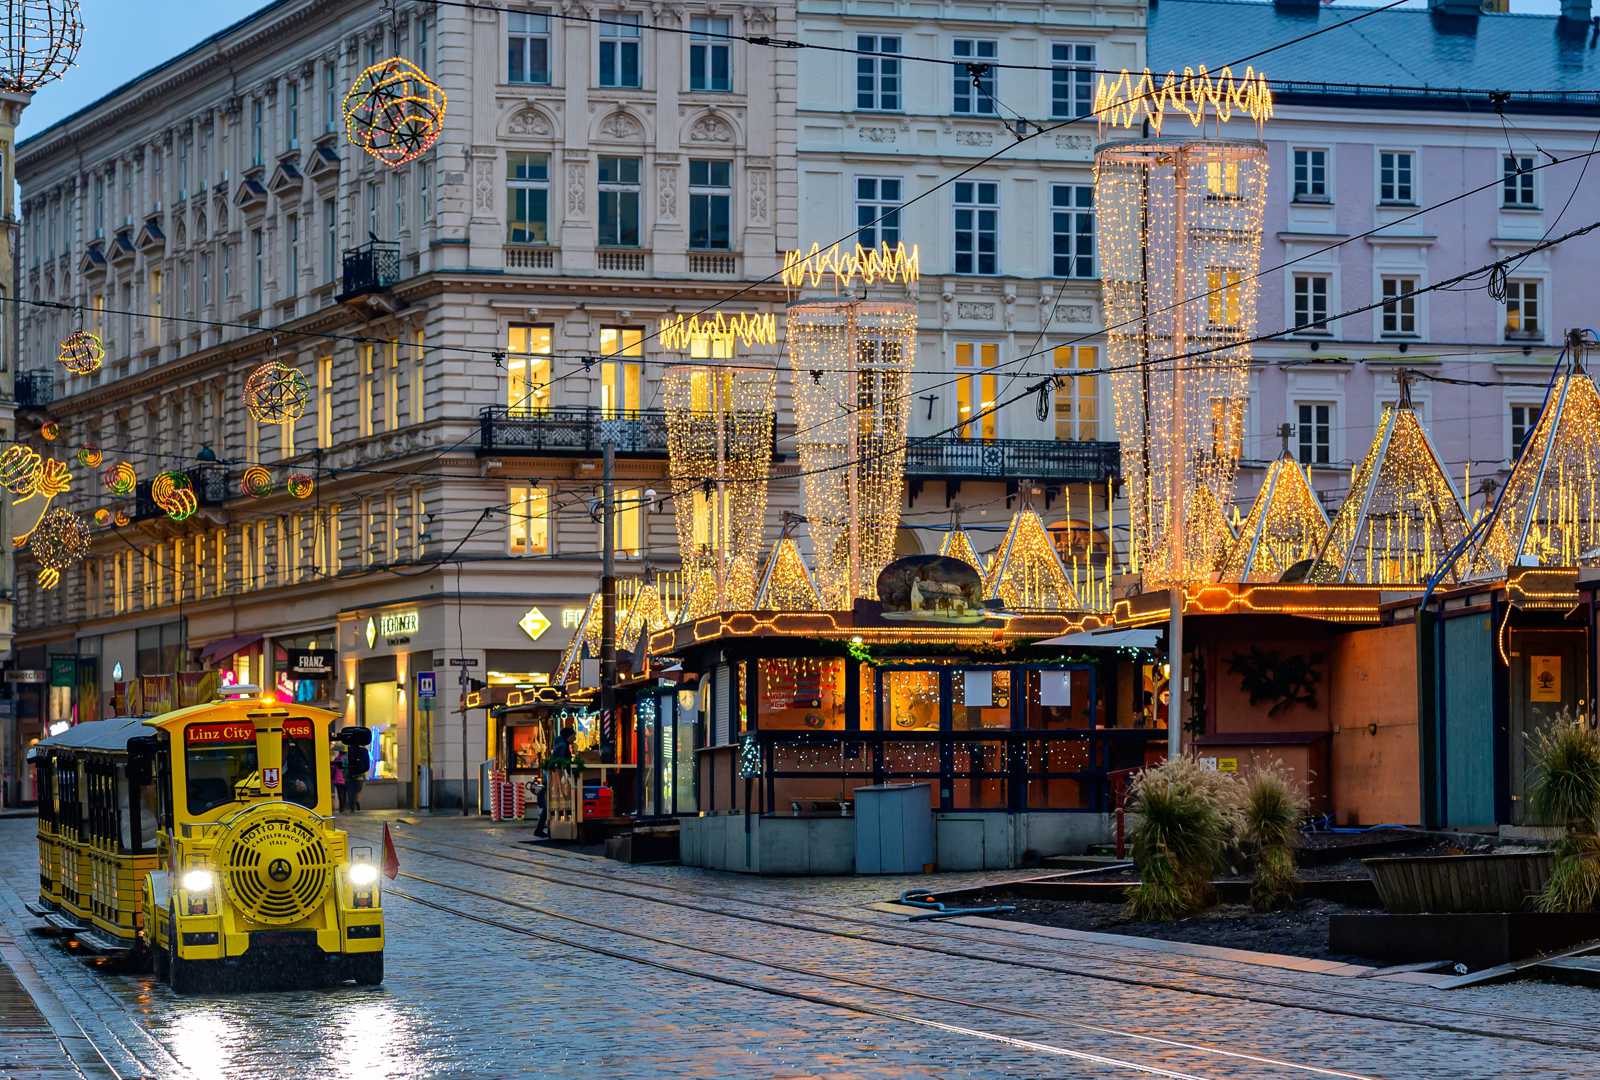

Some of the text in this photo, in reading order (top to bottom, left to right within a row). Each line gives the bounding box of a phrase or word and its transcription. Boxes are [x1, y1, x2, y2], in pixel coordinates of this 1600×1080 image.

[299, 655, 324, 667] FRANZ
[189, 726, 310, 740] Linz City ress
[243, 823, 313, 845] DOTTO TRAINS
